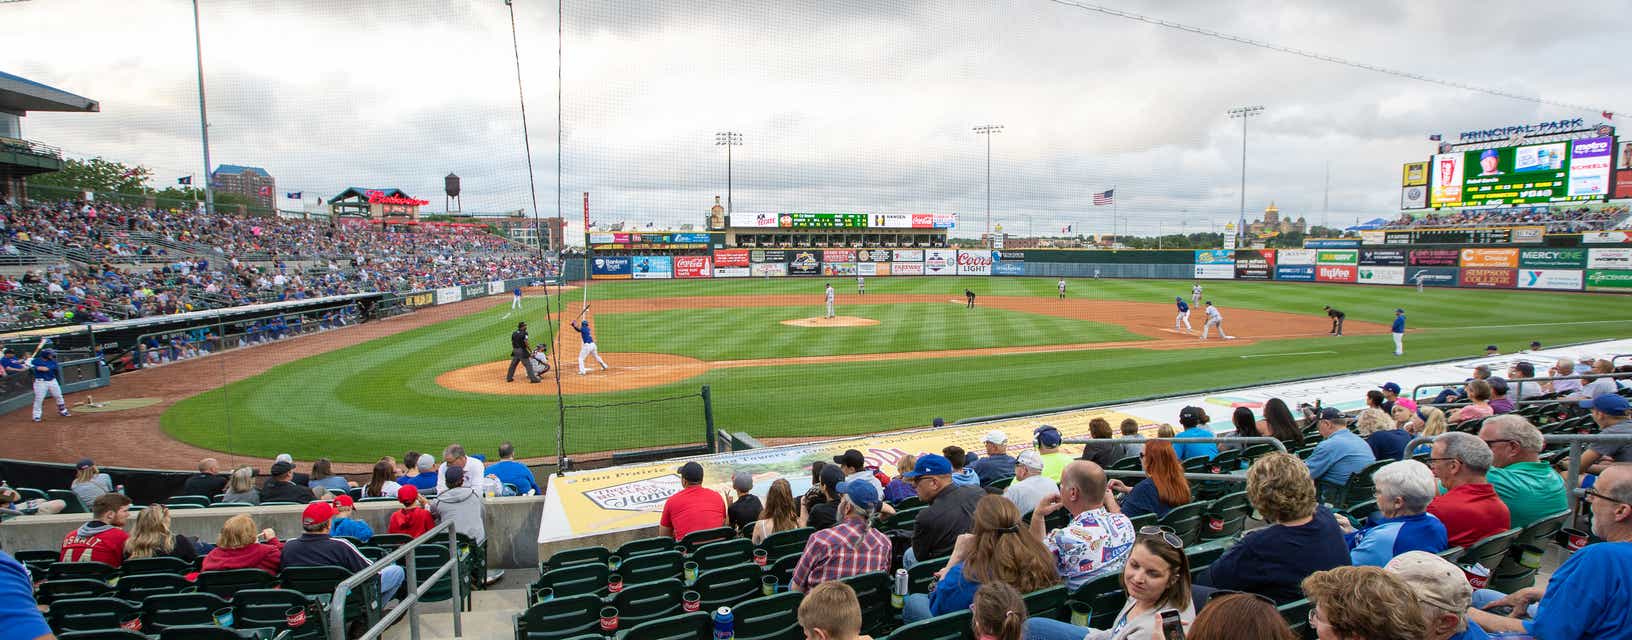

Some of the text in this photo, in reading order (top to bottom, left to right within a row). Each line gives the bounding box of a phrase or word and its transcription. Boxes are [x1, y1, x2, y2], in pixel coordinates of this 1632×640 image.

[1460, 117, 1584, 140] PRINCIPAL PARK
[1575, 142, 1608, 151] metro
[368, 190, 430, 206] Budweiser
[958, 253, 992, 265] Coors
[1522, 251, 1583, 260] MERCYONE
[1466, 269, 1509, 277] SIMPSON
[604, 489, 677, 507] Home
